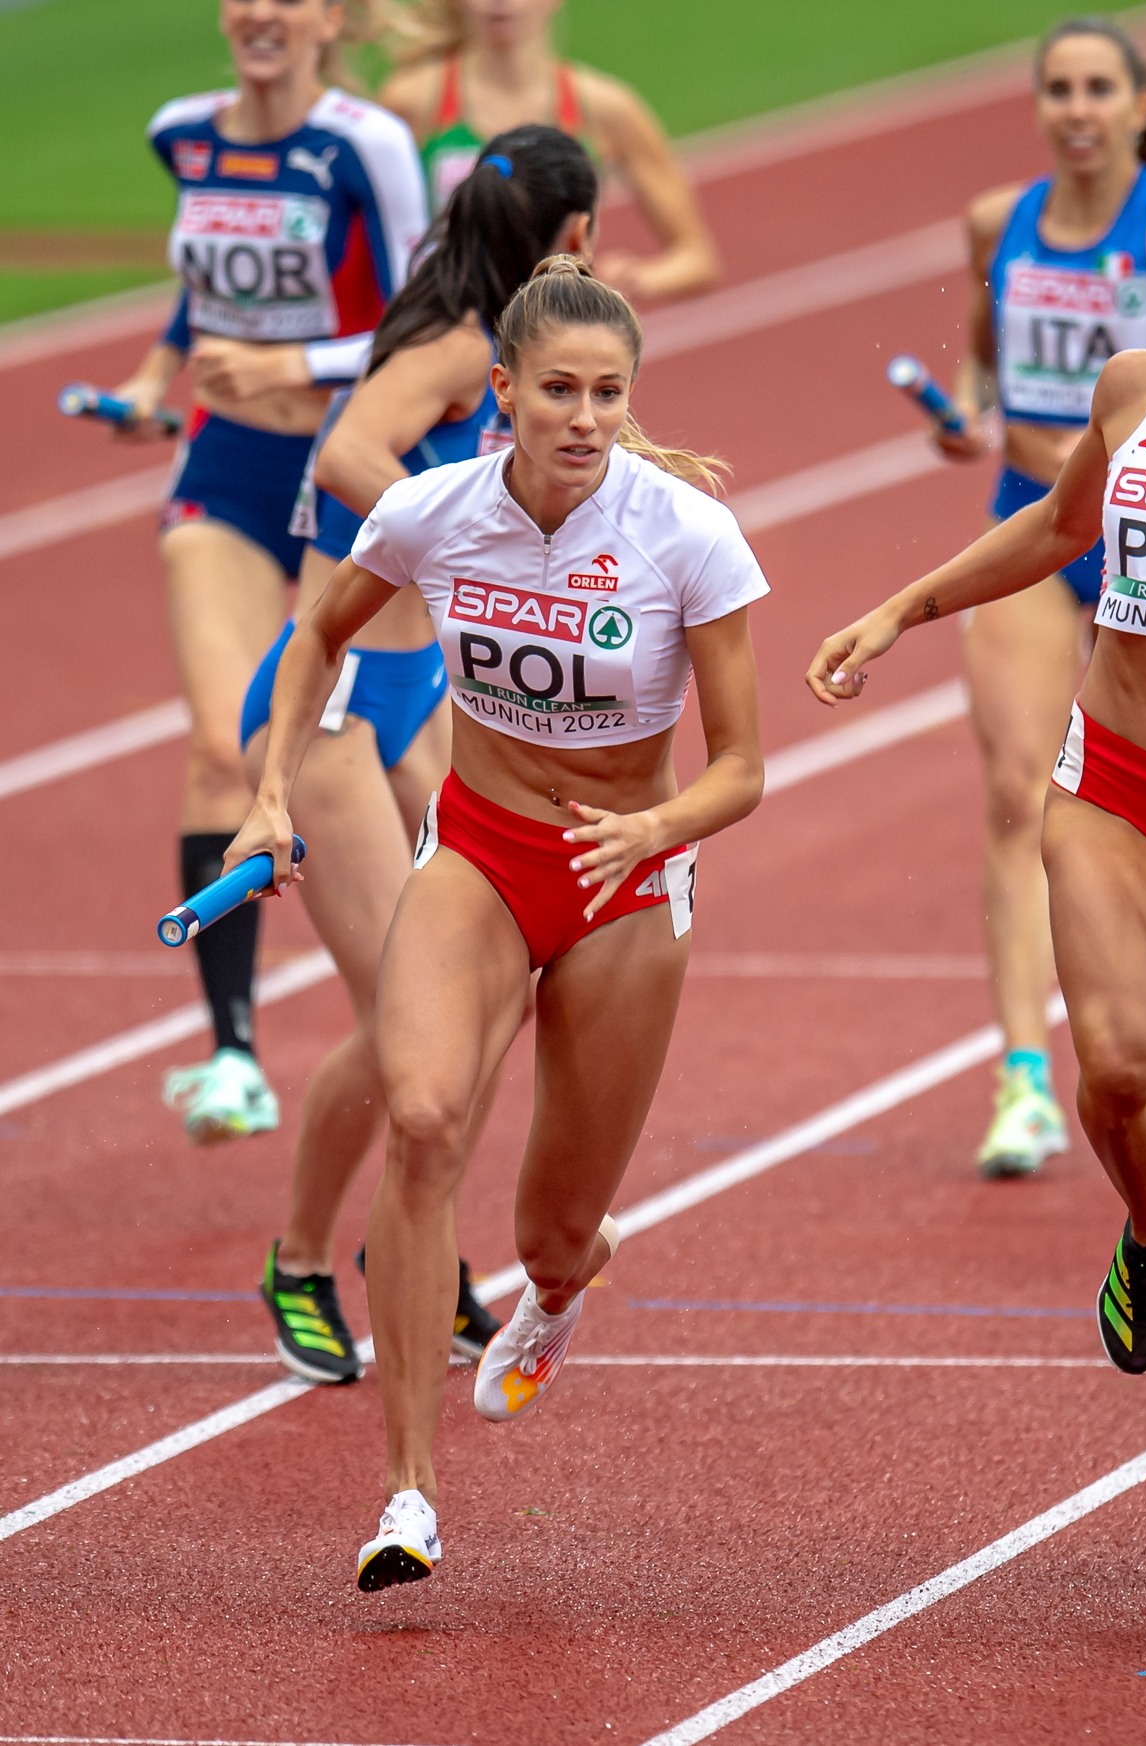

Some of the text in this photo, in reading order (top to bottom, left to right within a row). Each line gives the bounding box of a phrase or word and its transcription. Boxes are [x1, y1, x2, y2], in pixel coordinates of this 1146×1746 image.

[183, 243, 318, 301] NOR
[1031, 317, 1120, 374] ITA
[571, 576, 615, 590] ORLEN
[454, 584, 582, 637] SPAR
[460, 631, 617, 703] POL
[462, 692, 627, 734] MUNICH 2022
[497, 689, 528, 707] RUN
